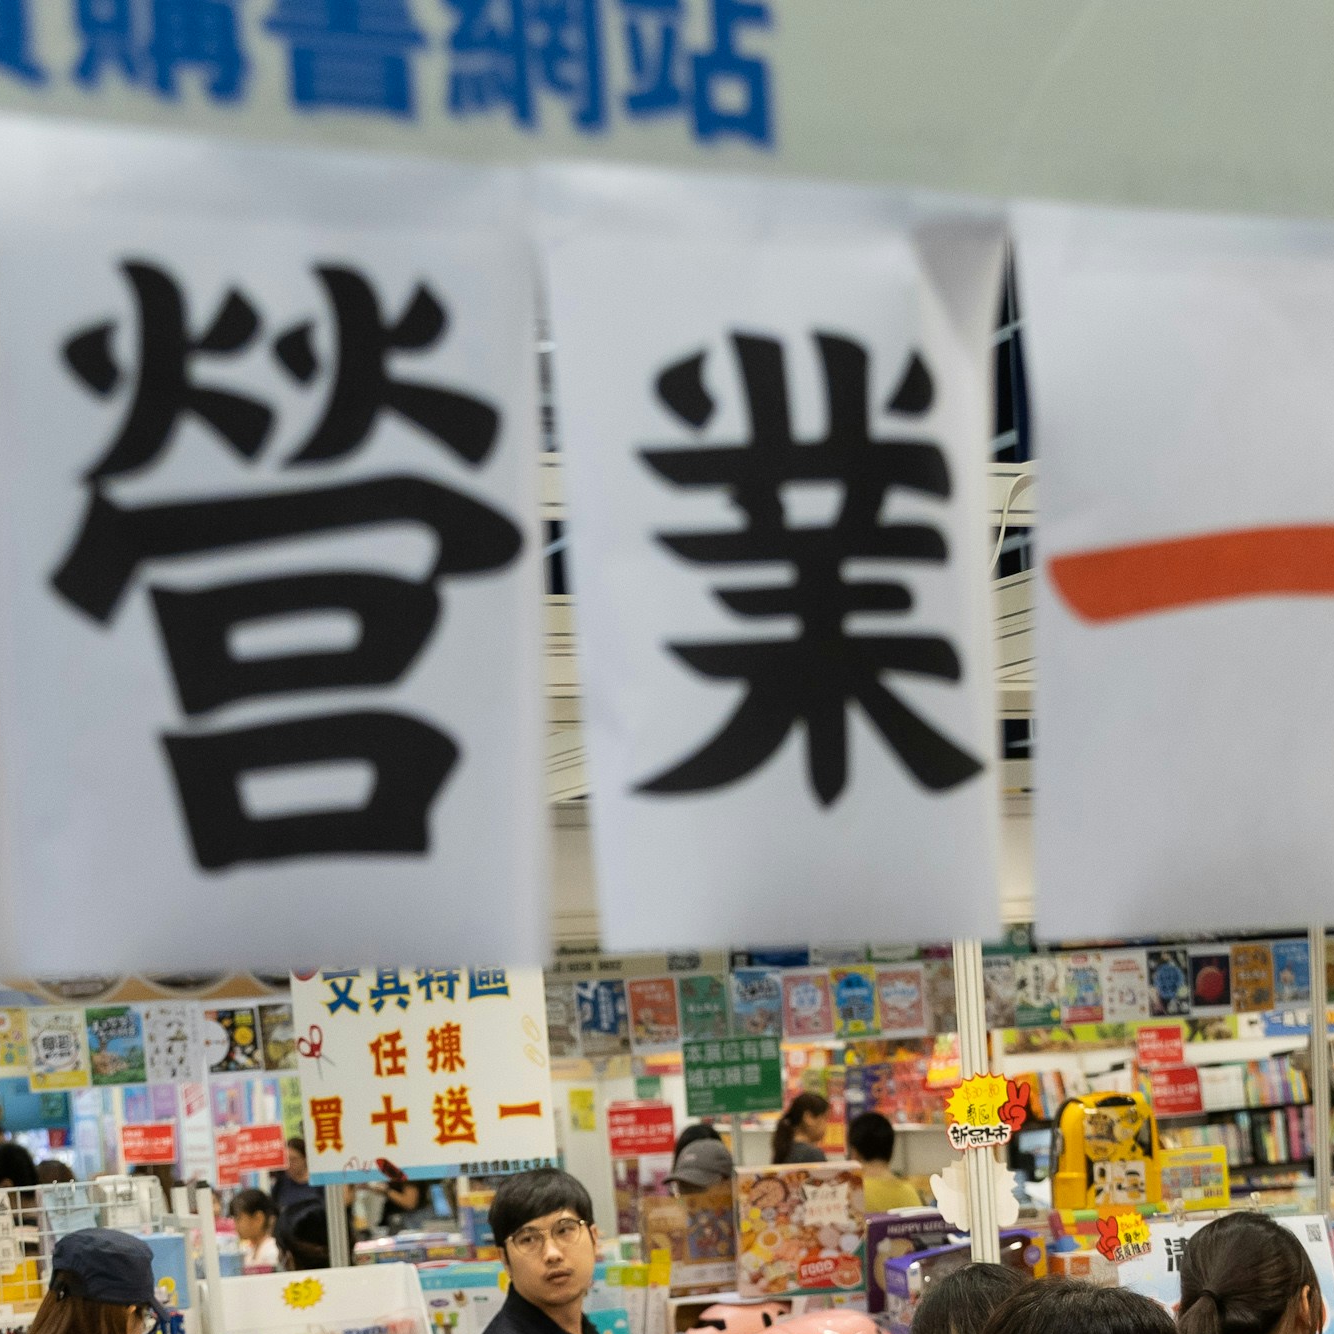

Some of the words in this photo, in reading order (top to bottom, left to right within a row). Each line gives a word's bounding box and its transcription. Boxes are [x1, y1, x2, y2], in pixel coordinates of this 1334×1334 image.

[321, 967, 510, 1015] 文具特區
[370, 1022, 465, 1077] 任揀
[310, 1085, 541, 1153] 買十送一
[950, 1126, 1009, 1146] 新品上市
